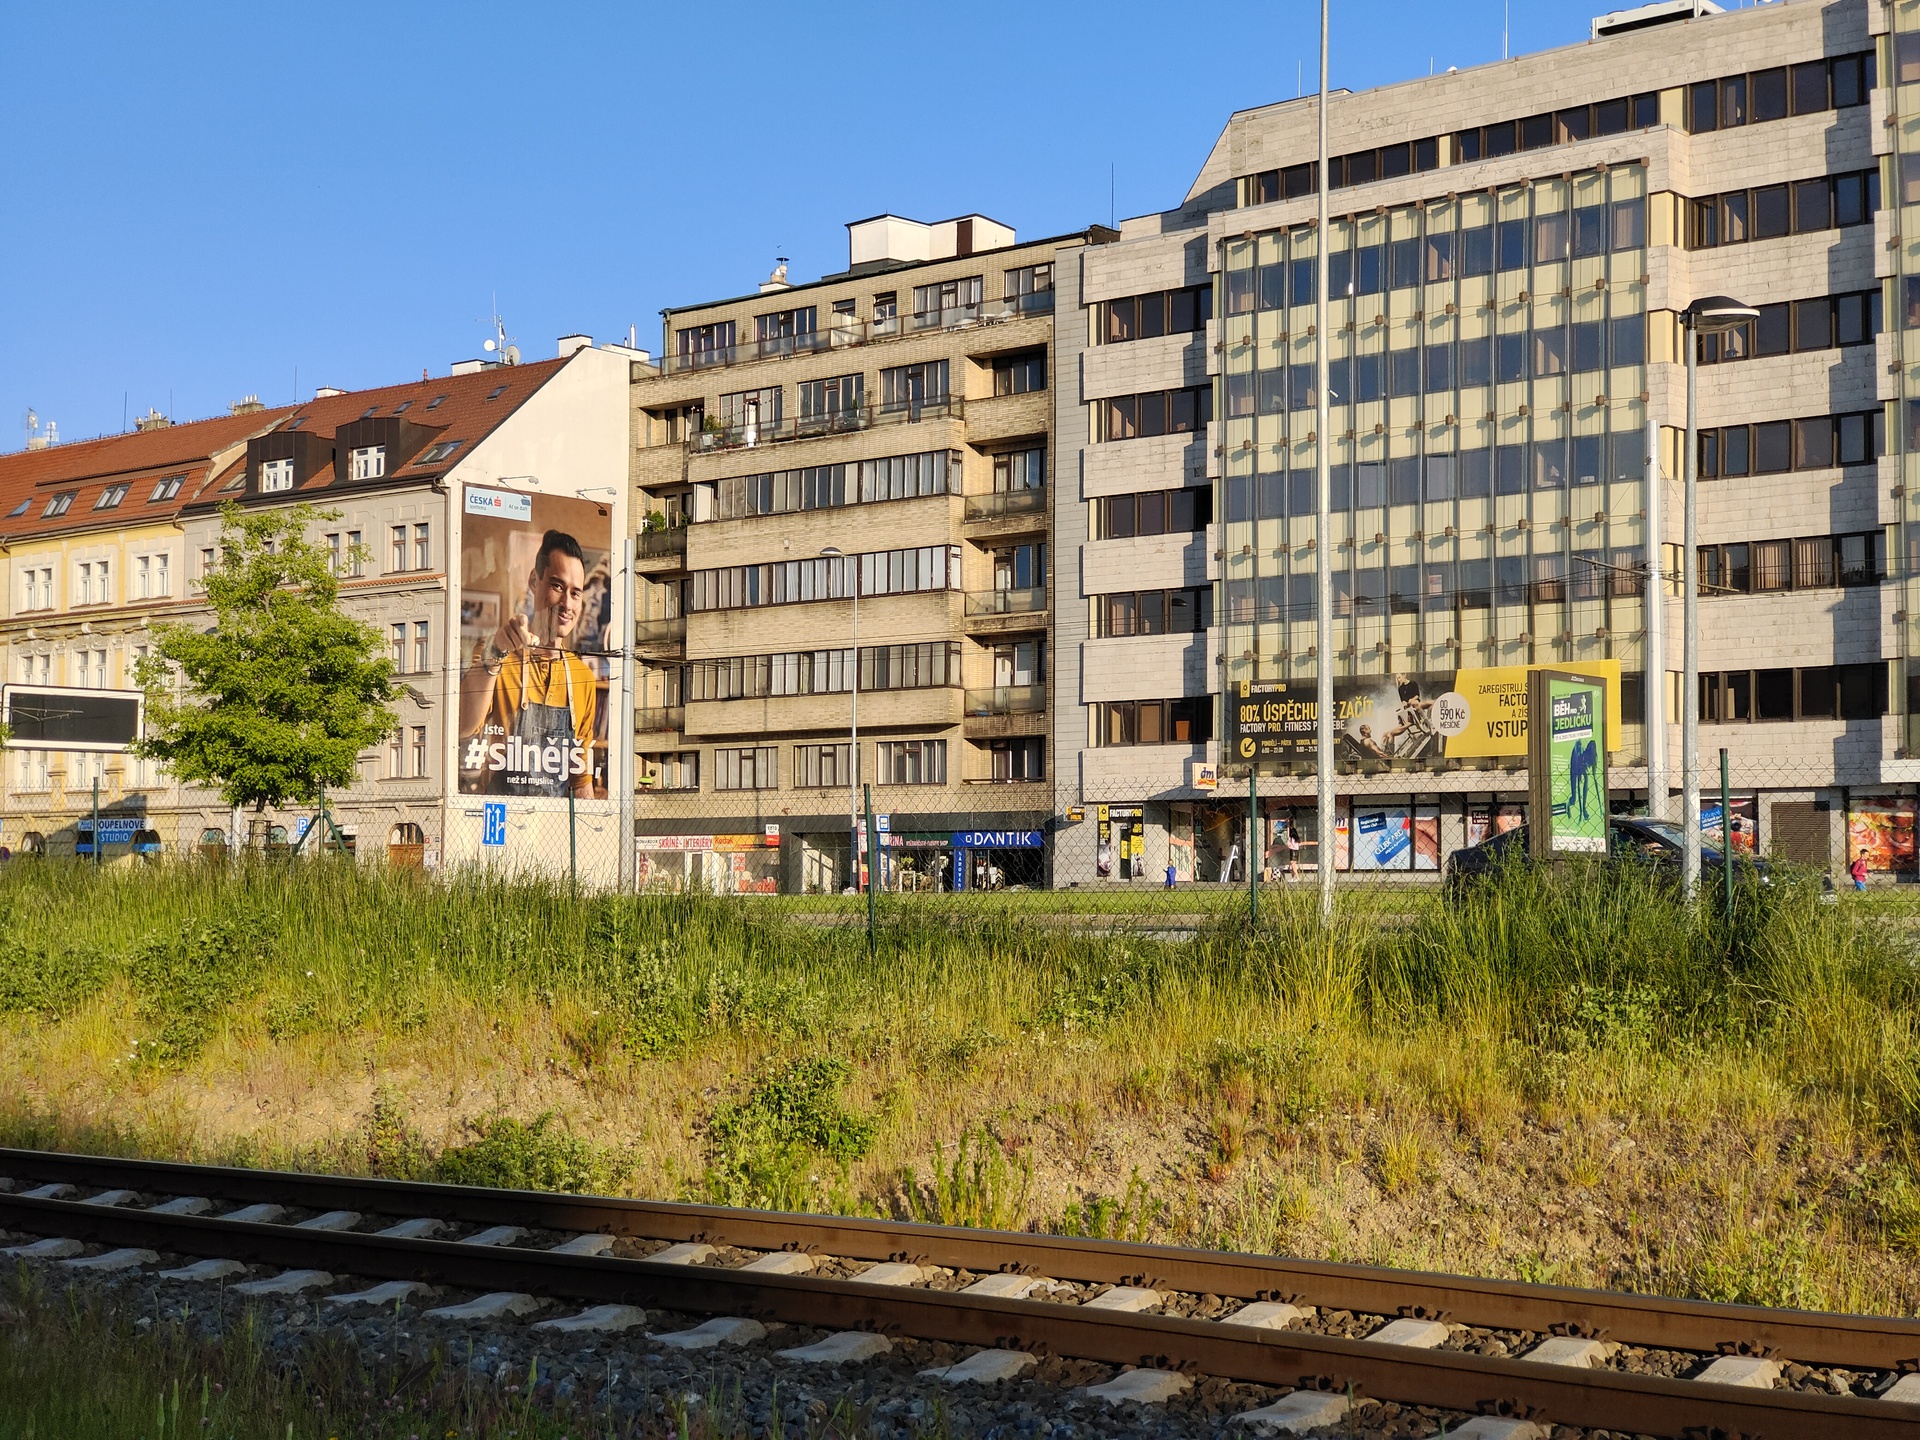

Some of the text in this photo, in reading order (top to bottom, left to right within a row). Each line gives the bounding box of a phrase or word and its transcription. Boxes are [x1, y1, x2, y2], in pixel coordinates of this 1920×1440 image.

[470, 494, 493, 506] ČESKÁ
[1478, 683, 1523, 694] ZAREGISTRUJ
[1440, 700, 1448, 709] OD
[1499, 693, 1528, 707] FACTO
[1240, 704, 1260, 723] 80%
[1263, 699, 1318, 722] ÚSPĚCHU
[1339, 696, 1374, 719] ZAČÍT
[1440, 708, 1466, 720] 590 Kč
[1512, 708, 1528, 718] A ZÍS
[1554, 700, 1571, 717] BĚH
[1240, 722, 1266, 734] FACTORY
[1267, 721, 1283, 732] PRO.
[1284, 720, 1311, 732] FITNESS
[1332, 719, 1347, 730] EBE.
[1555, 713, 1591, 730] JEDLIČKU
[484, 724, 505, 735] Jste
[464, 735, 602, 782] #silnější,
[1200, 766, 1214, 779] dm
[507, 775, 554, 785] než si myslíte
[299, 819, 306, 831] P
[101, 832, 129, 842] STUDIO
[714, 836, 734, 845] Kodak
[974, 831, 1032, 846] DANTIK
[1374, 829, 1404, 855] CLUBCARD
